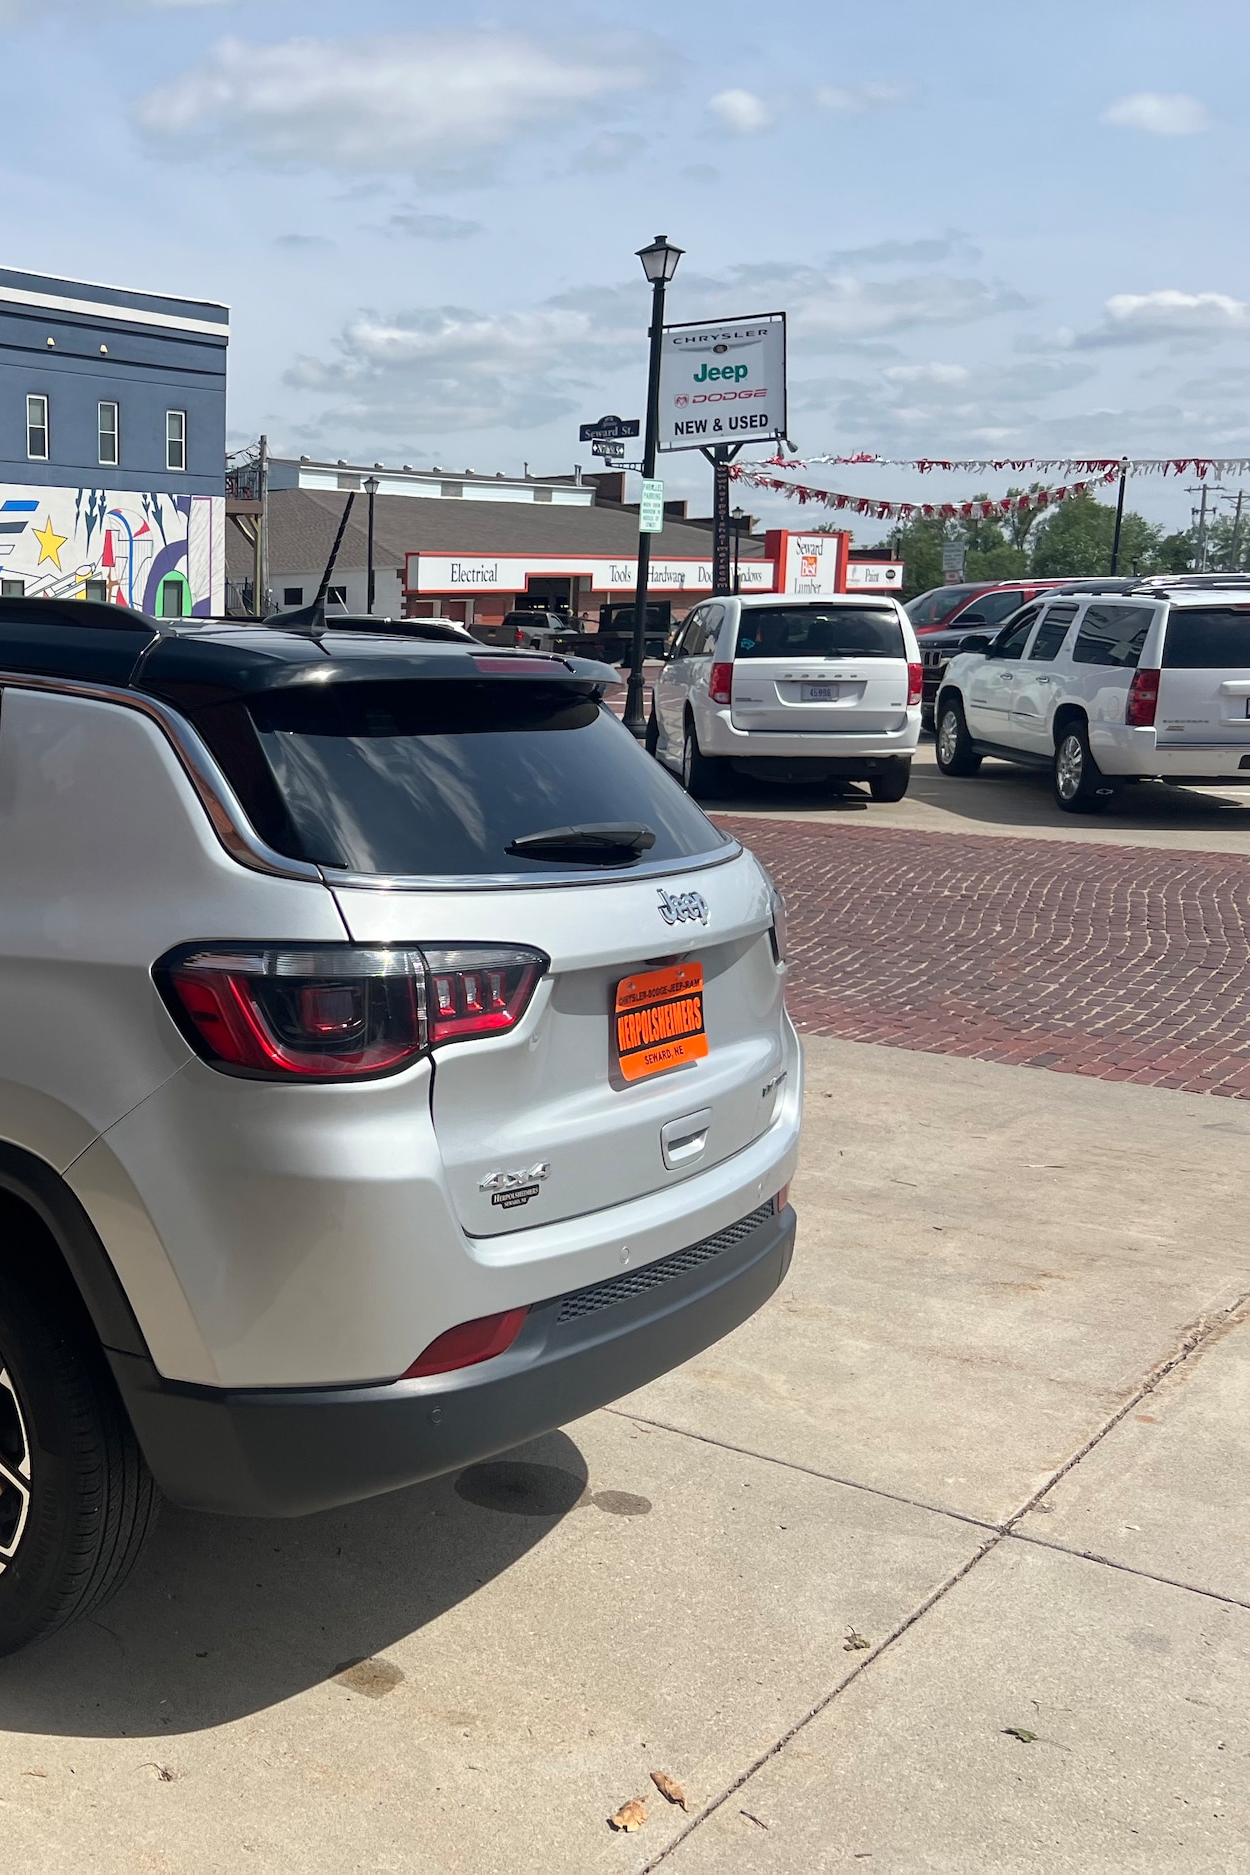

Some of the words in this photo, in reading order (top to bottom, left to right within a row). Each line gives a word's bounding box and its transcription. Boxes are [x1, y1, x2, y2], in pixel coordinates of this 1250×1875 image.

[673, 329, 768, 345] CHRYSLER
[693, 363, 748, 383] Jeep
[692, 388, 768, 404] DODGE
[584, 427, 618, 438] Seward
[621, 426, 634, 435] St.
[674, 420, 707, 435] NEW
[712, 418, 723, 432] &
[728, 414, 768, 430] USED
[796, 536, 824, 555] Seward
[451, 563, 498, 582] Electrical
[609, 565, 631, 582] Tools
[646, 565, 685, 583] Hardware
[802, 559, 816, 576] Best
[865, 568, 879, 582] Paint
[794, 577, 821, 594] Lumber
[656, 888, 709, 925] Jeep
[617, 997, 702, 1051] HERPOLSHEIMERS
[645, 1048, 674, 1065] SEWARD,
[674, 1045, 684, 1057] NE
[479, 1162, 551, 1192] 4x4
